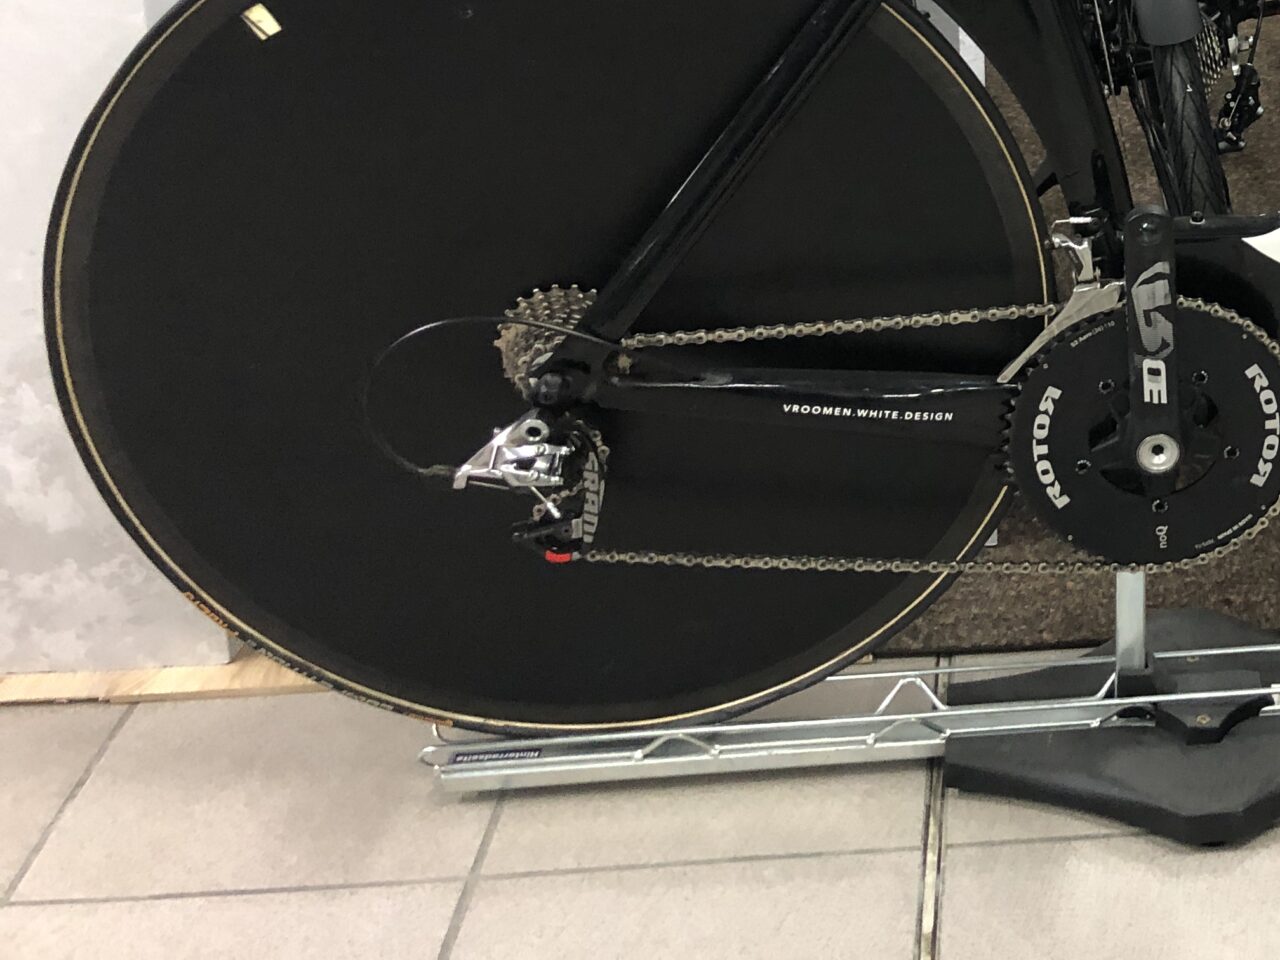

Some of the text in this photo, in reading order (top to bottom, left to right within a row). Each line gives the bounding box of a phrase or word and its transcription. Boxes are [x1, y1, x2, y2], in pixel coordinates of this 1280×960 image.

[782, 403, 954, 422] VROOMEN.WHITE.DESIGN
[1032, 384, 1072, 510] ROTOR
[583, 451, 599, 543] SRAM
